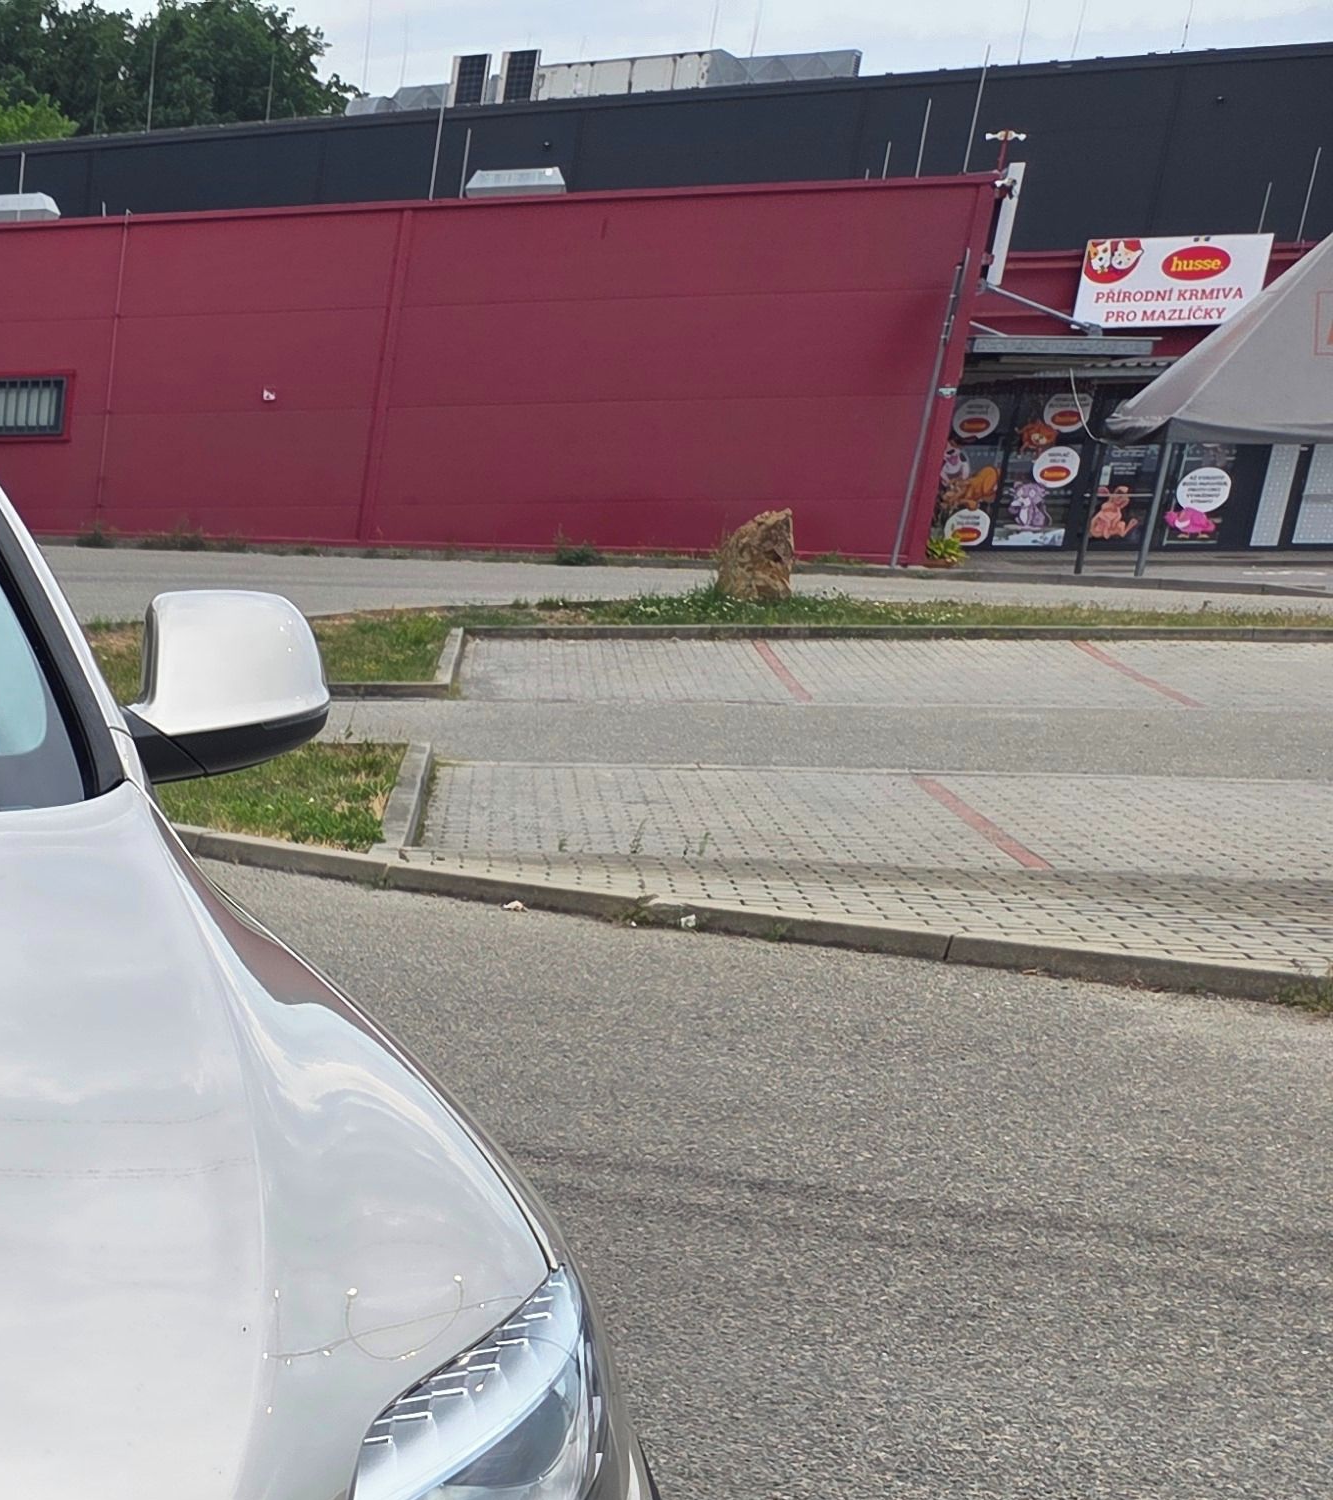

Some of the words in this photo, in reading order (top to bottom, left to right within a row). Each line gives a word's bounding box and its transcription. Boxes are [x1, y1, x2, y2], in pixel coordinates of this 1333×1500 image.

[1170, 256, 1222, 272] husse
[1094, 287, 1174, 303] PŘÍRODNÍ
[1177, 287, 1243, 302] KRMIVA
[1104, 310, 1137, 322] PRO
[1141, 307, 1226, 322] MAZLÍČKY
